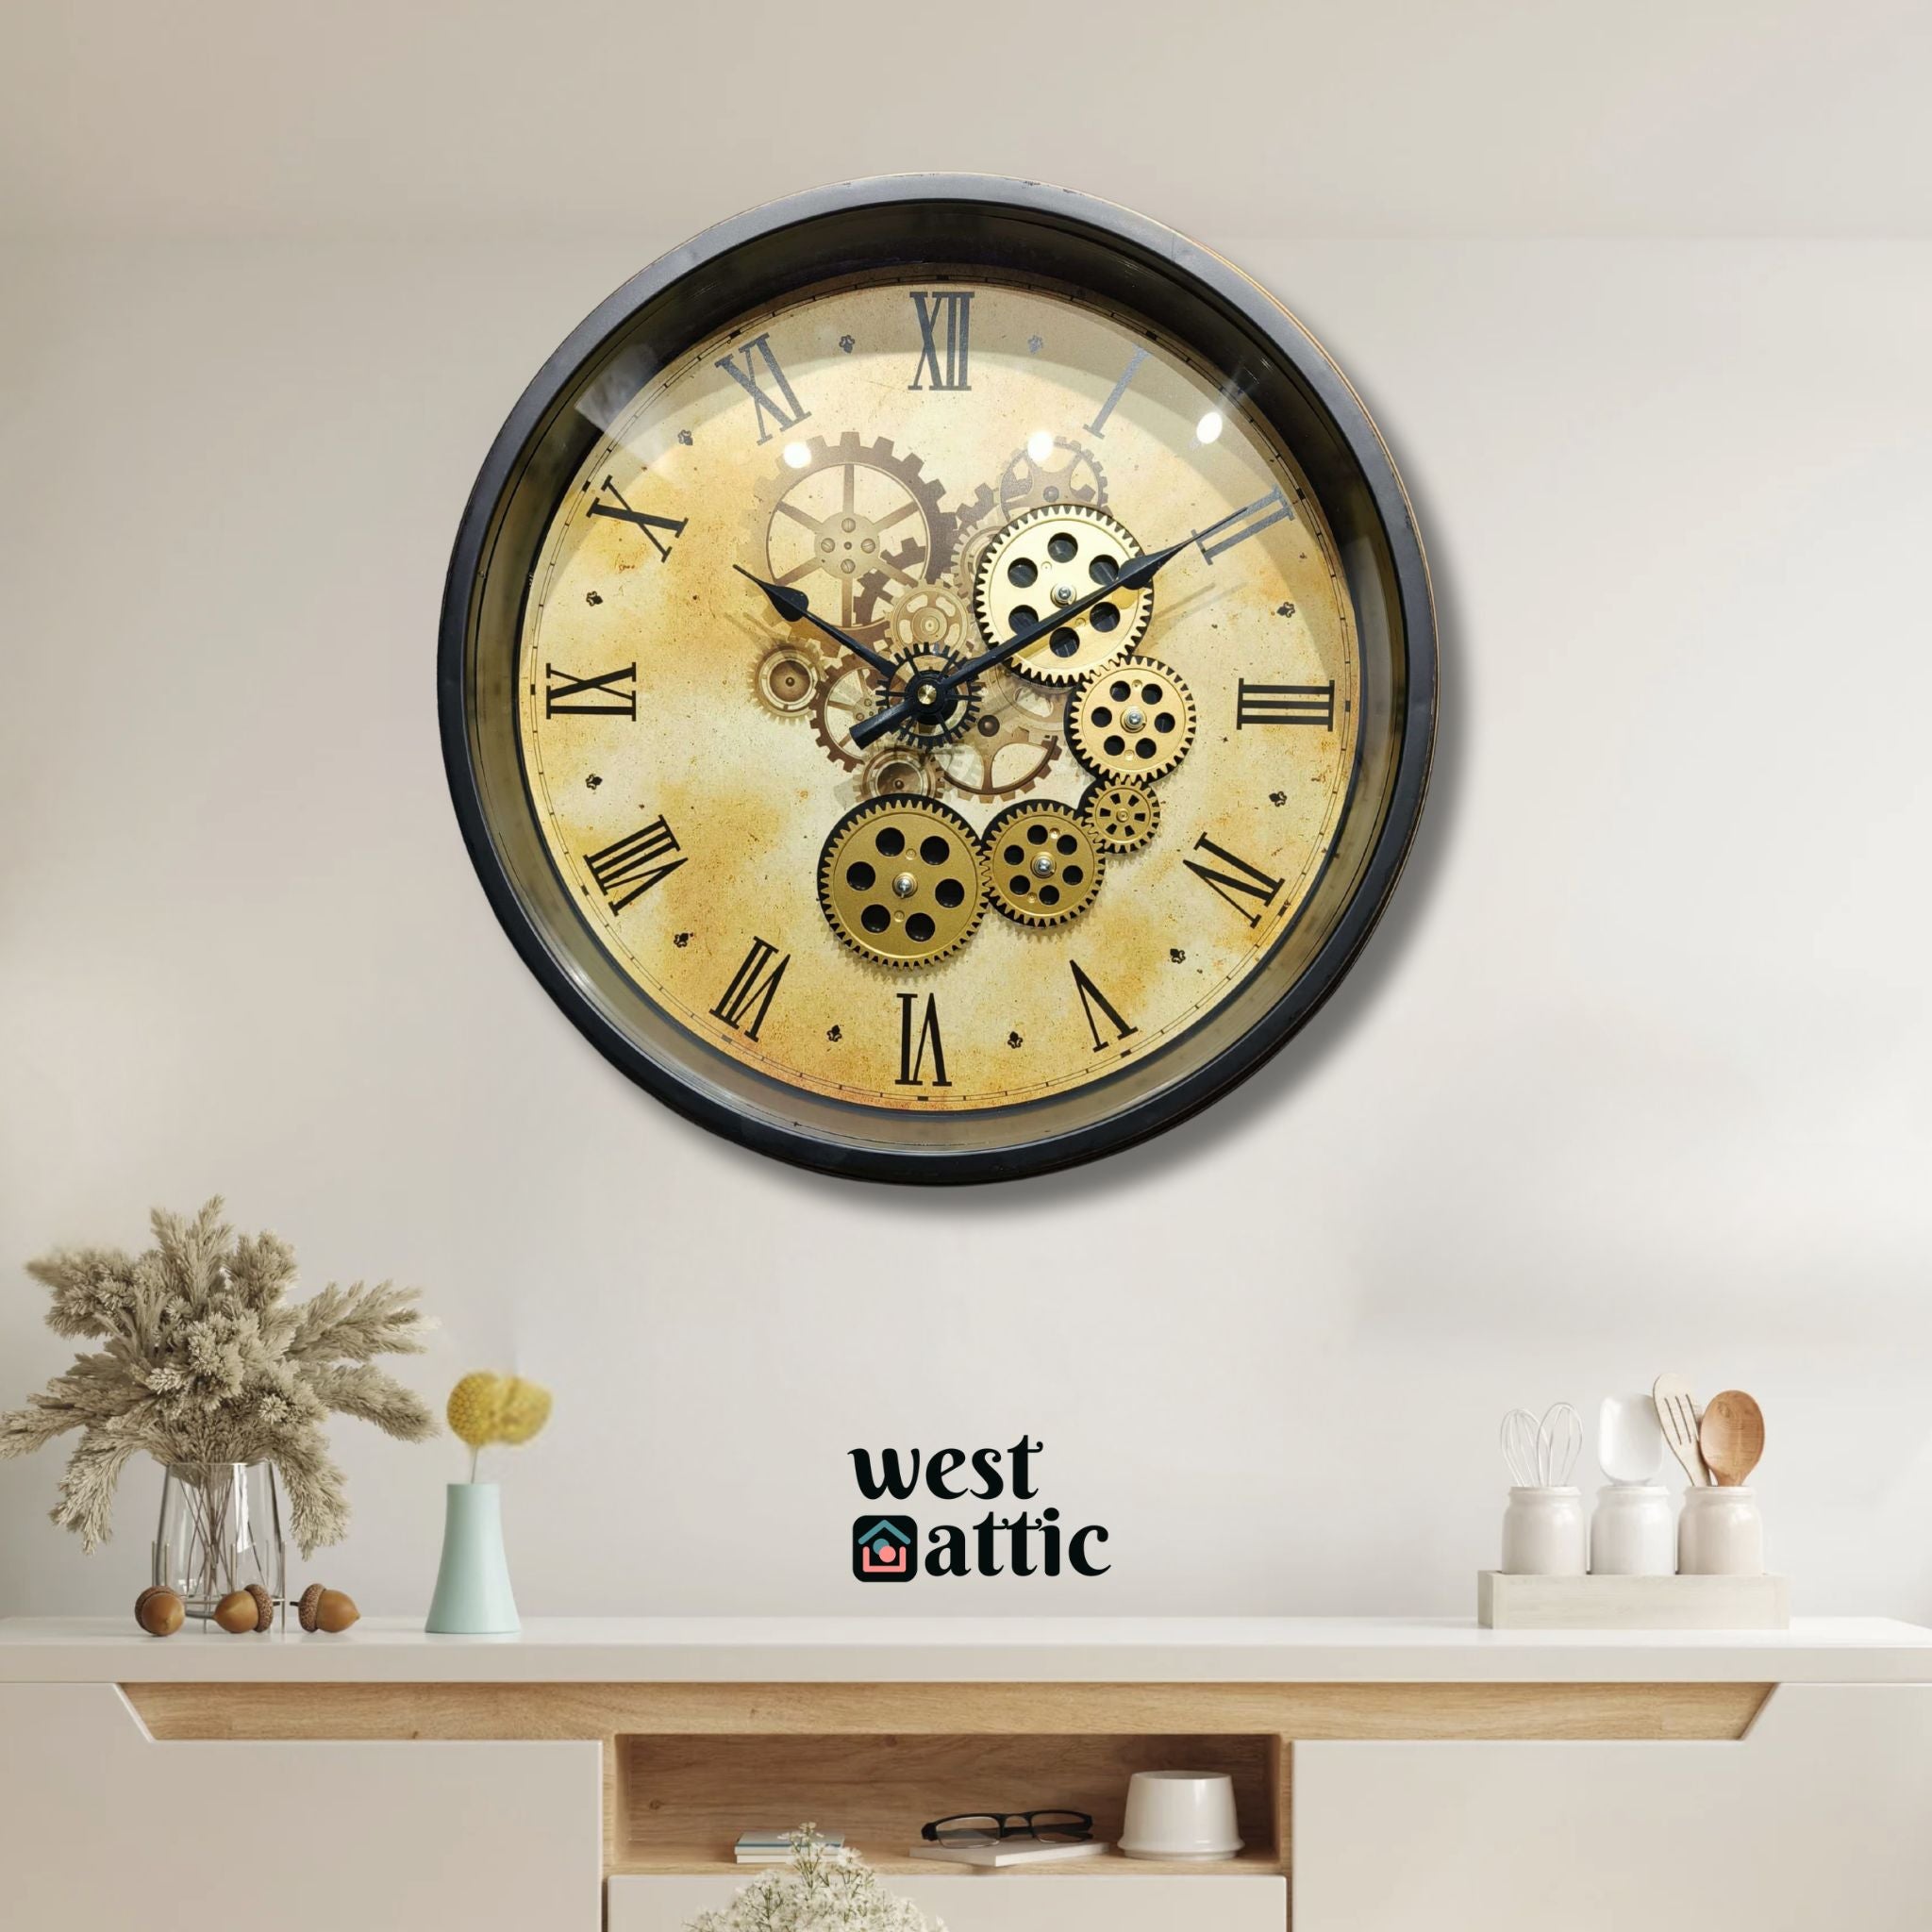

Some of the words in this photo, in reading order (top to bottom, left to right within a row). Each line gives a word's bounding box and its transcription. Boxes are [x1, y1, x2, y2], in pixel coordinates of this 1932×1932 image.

[908, 291, 974, 391] XII
[715, 334, 811, 445] XI
[1083, 345, 1152, 438] I
[586, 476, 689, 563] X
[1191, 485, 1293, 565] II
[545, 662, 636, 721] IX
[1238, 678, 1334, 731] III
[583, 814, 689, 915] VIII
[1182, 832, 1284, 927] IV
[709, 936, 791, 1041] VII
[1069, 960, 1138, 1052] V
[894, 992, 953, 1086] VI
